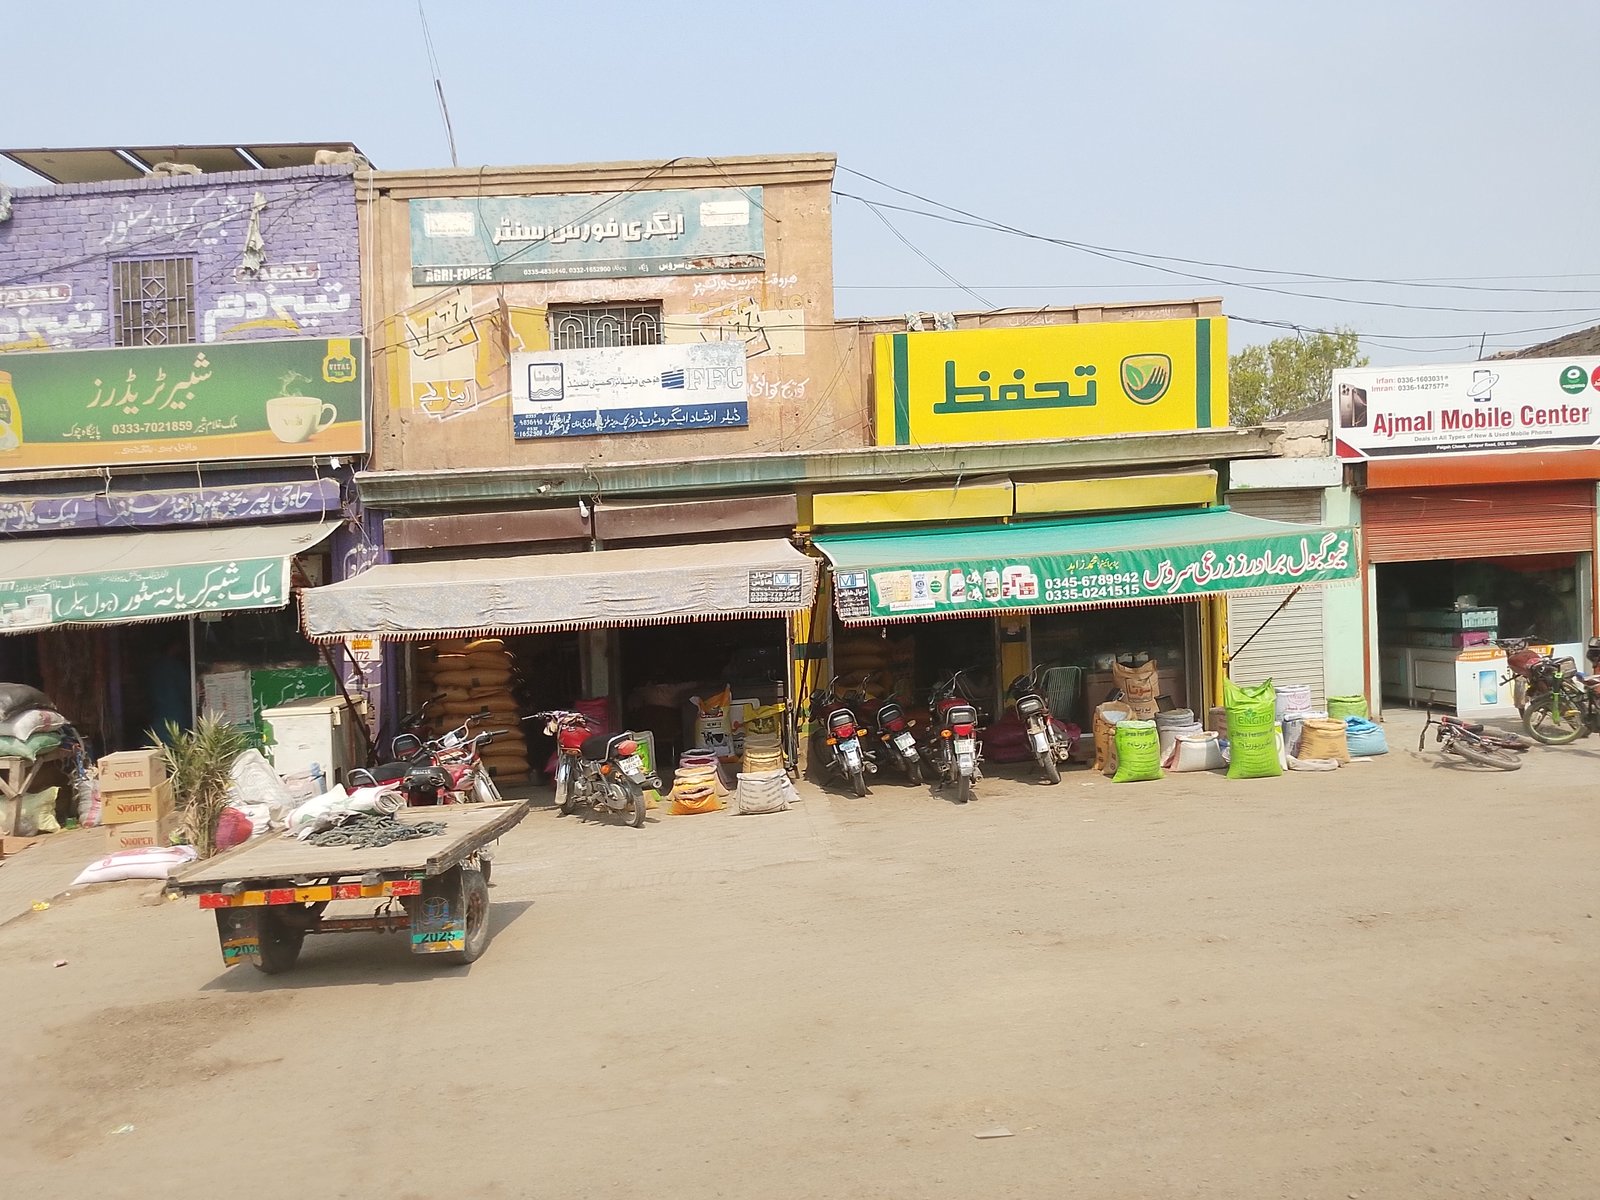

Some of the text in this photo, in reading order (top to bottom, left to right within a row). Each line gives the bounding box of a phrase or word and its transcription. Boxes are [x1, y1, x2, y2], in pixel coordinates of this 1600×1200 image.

[492, 211, 685, 246] ایگری فورس سنٹر
[425, 267, 493, 283] AGRI-FORCE
[328, 363, 351, 371] VITAL
[86, 351, 213, 415] شبیر ٹریڈرز
[686, 366, 743, 391] FFC
[933, 360, 1098, 415] تحفظ
[1371, 383, 1445, 393] Imran: 0336-1427577
[689, 410, 717, 425] ارشاد
[720, 408, 741, 424] ڈیلر
[1373, 404, 1590, 438] Ajmal Mobile Center
[112, 420, 193, 436] 0333-7021859
[1447, 433, 1466, 441] Types
[240, 489, 273, 517] پیر
[272, 486, 313, 516] حاجی
[1143, 532, 1349, 594] نیو گبول برادرز زرعی سروس
[198, 561, 242, 608] شبیر
[227, 562, 275, 602] ملک
[1045, 572, 1139, 589] 0345-6789942
[121, 581, 165, 612] سٹور
[1045, 584, 1140, 602] 0335-0241515
[1237, 714, 1273, 725] ENGRO
[114, 770, 144, 781] SOOPER
[116, 803, 152, 816] SOOPER
[120, 837, 154, 849] SOOPER
[421, 931, 456, 943] 2025
[233, 944, 261, 957] 202
